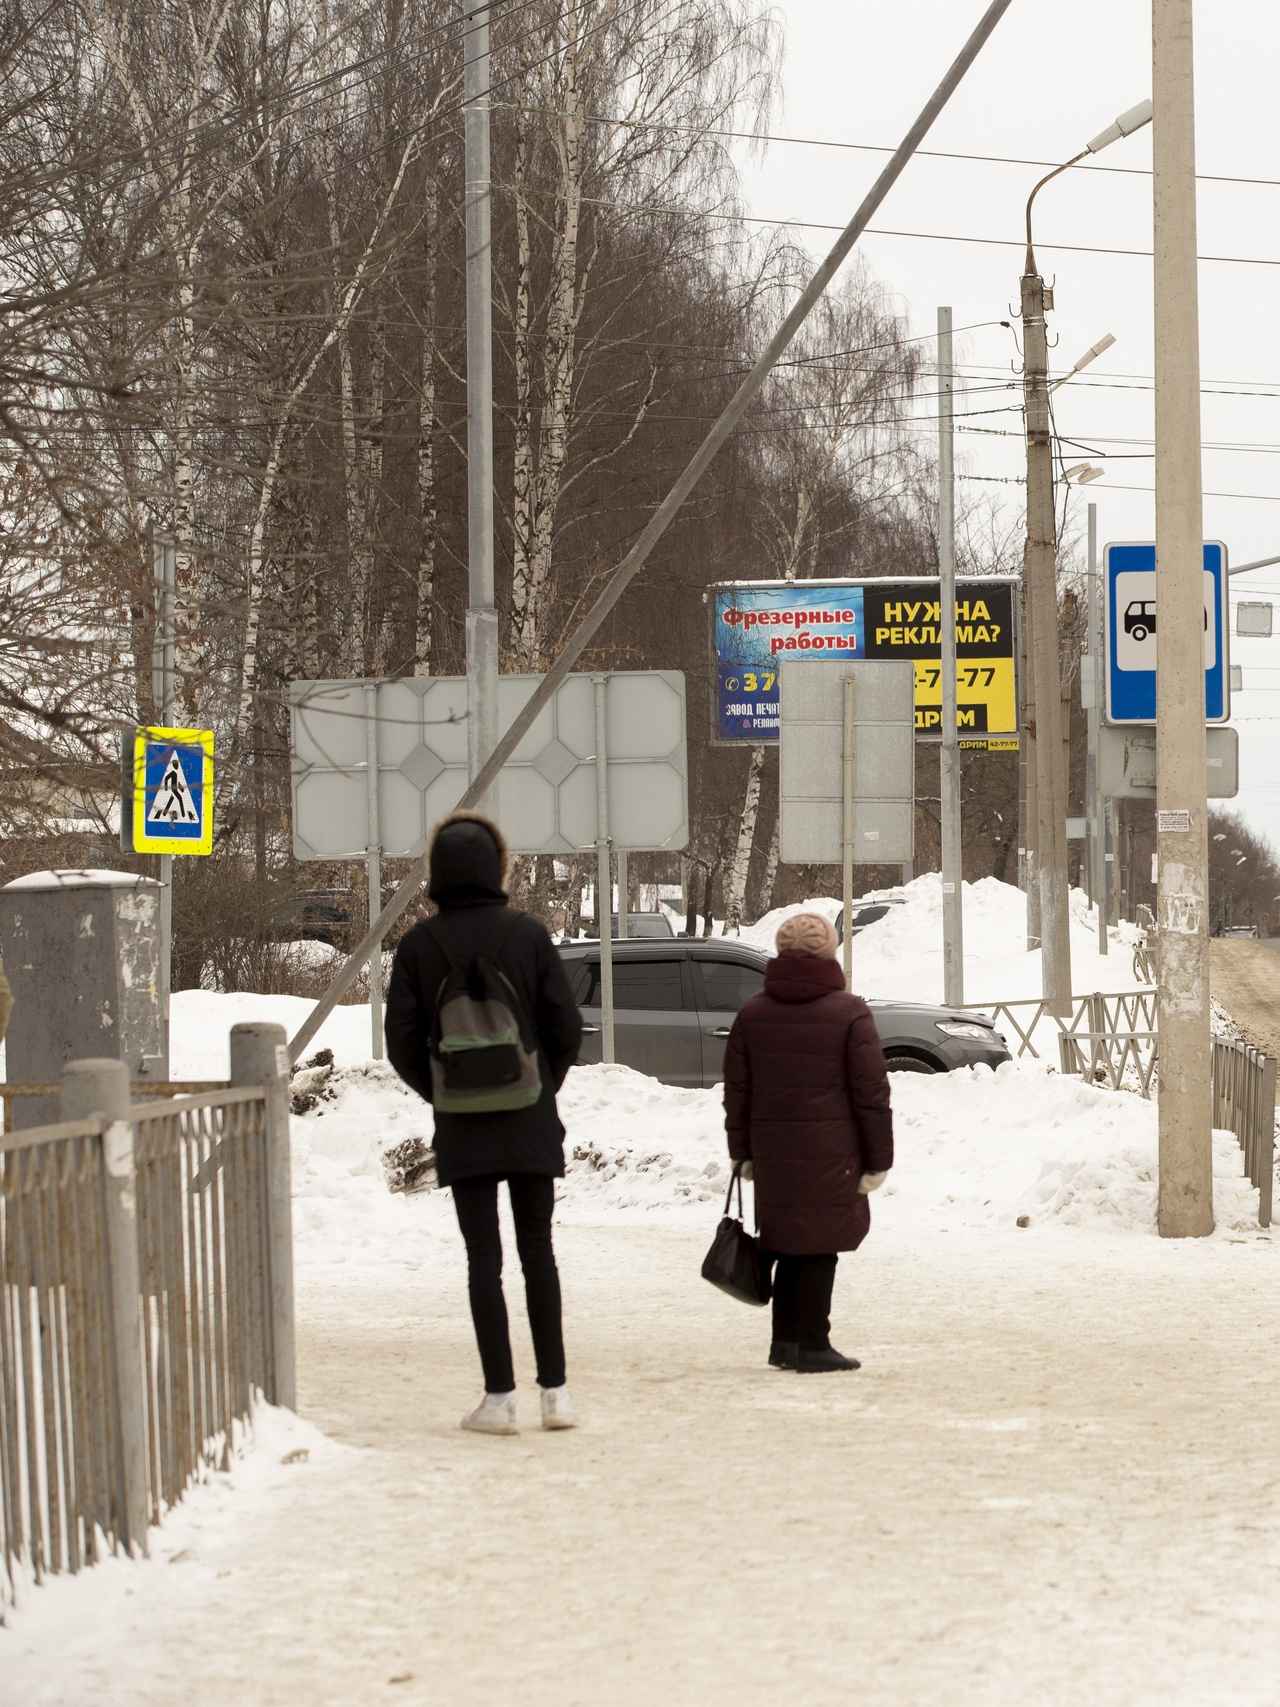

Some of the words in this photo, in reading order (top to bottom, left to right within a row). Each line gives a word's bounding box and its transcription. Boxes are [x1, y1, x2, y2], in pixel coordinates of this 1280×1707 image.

[722, 607, 855, 631] Фрезерные
[883, 600, 992, 623] НУЖНА
[770, 631, 856, 655] работы
[875, 624, 1002, 645] РЕКЛМА?
[743, 673, 780, 692] 37
[725, 703, 754, 717] ЗАВОД
[914, 710, 975, 728] ДРМ
[960, 741, 987, 749] ДРИМ
